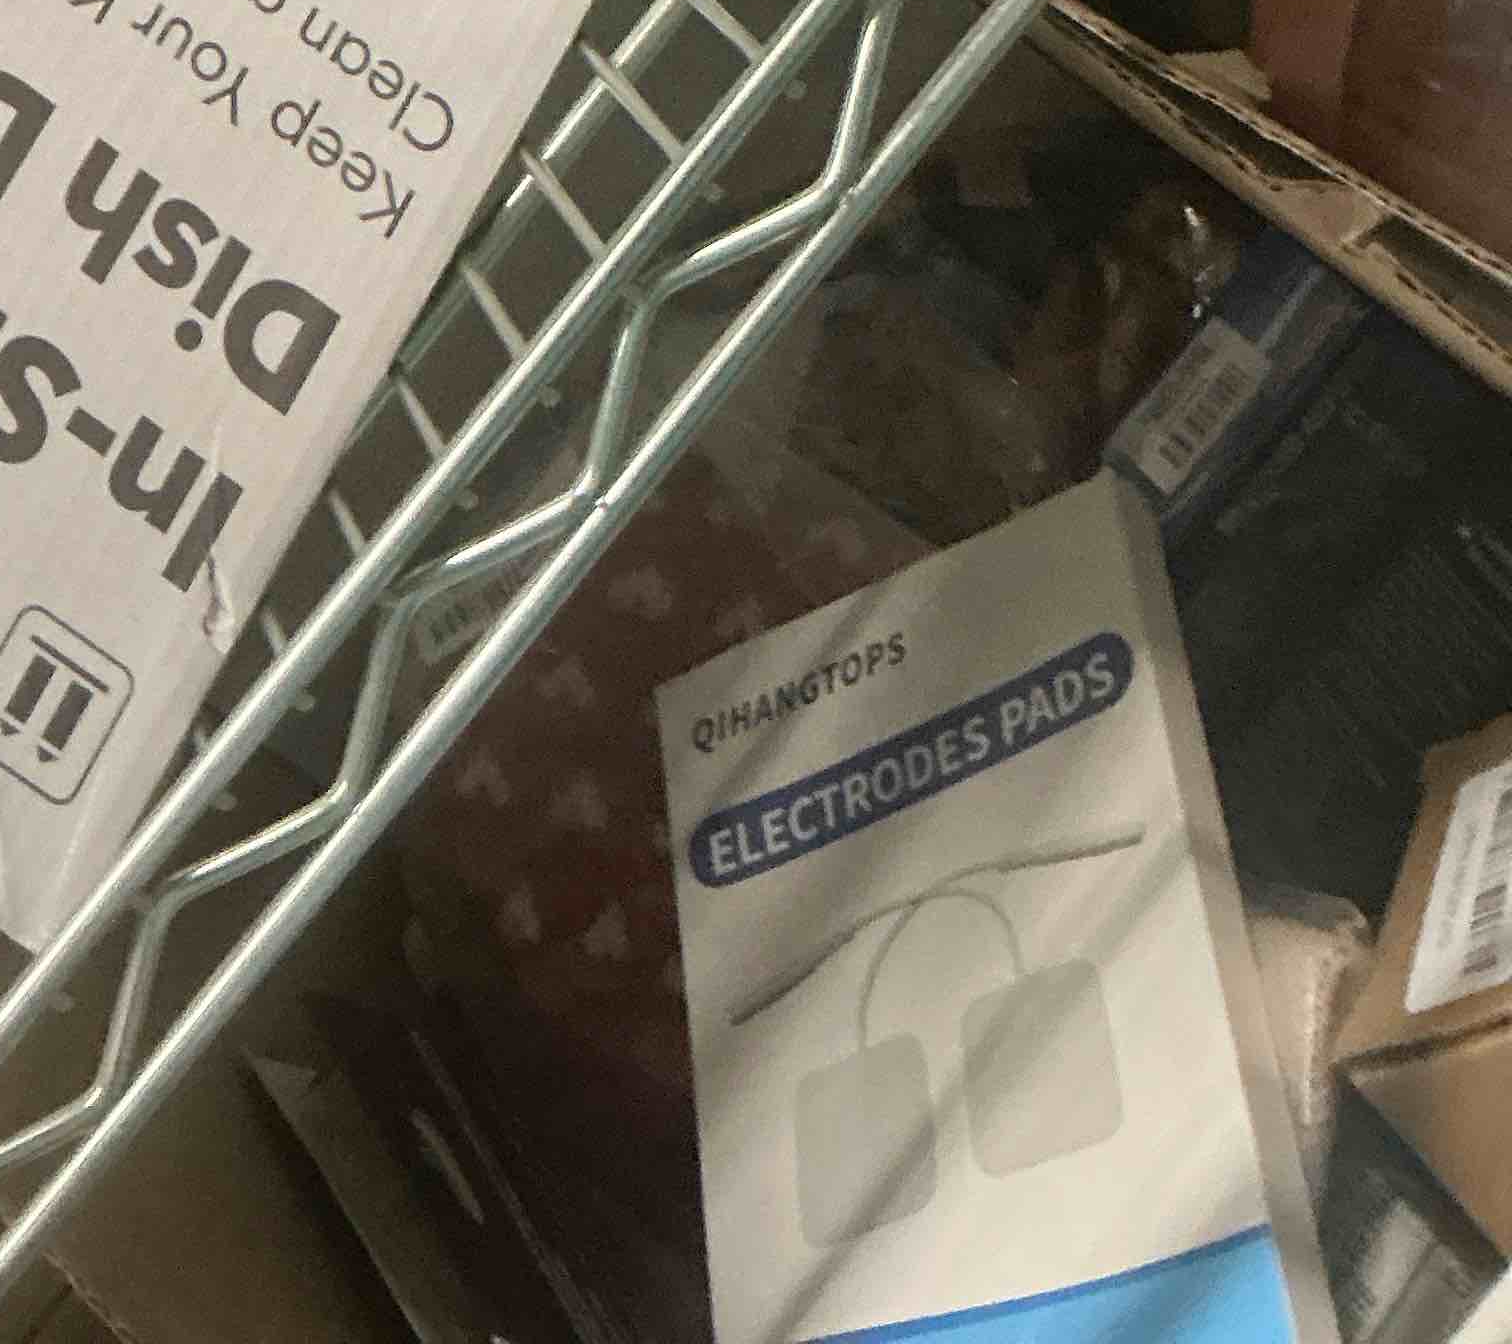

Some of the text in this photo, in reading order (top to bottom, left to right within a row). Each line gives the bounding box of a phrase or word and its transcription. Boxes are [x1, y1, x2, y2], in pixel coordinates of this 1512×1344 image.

[130, 3, 249, 127] Your
[299, 7, 455, 152] Clean
[270, 100, 416, 240] Keep
[64, 137, 341, 417] Dish
[691, 631, 907, 755] QIHANGTOPS
[709, 652, 1115, 877] ELECTRODES PADS
